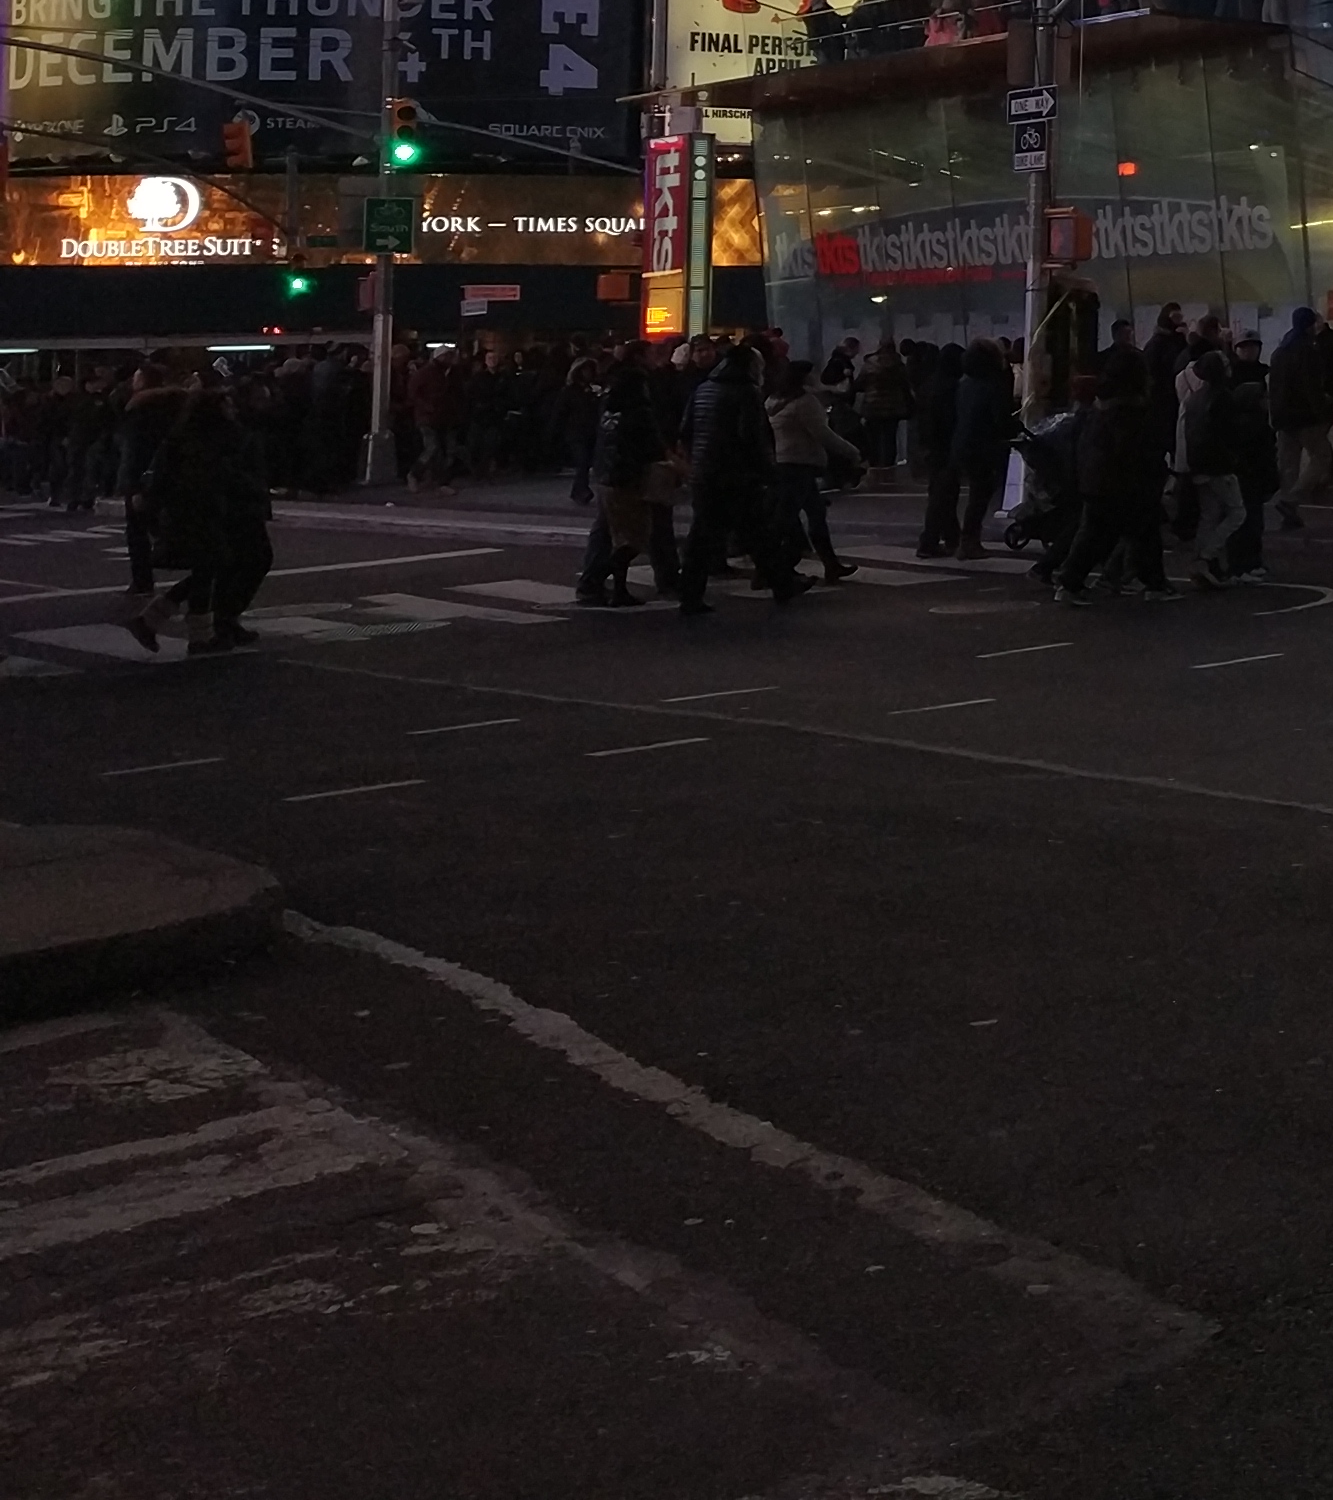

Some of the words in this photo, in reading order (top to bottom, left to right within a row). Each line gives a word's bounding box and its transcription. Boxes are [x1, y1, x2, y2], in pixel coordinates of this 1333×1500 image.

[689, 31, 743, 54] FINAL
[8, 25, 354, 92] DECEMBER
[539, 44, 598, 96] 4
[1014, 100, 1029, 113] ONE
[135, 116, 197, 133] PS4
[566, 126, 606, 139] ENIX
[653, 147, 681, 273] tkts
[421, 216, 481, 233] YORK
[513, 216, 578, 233] TIMES
